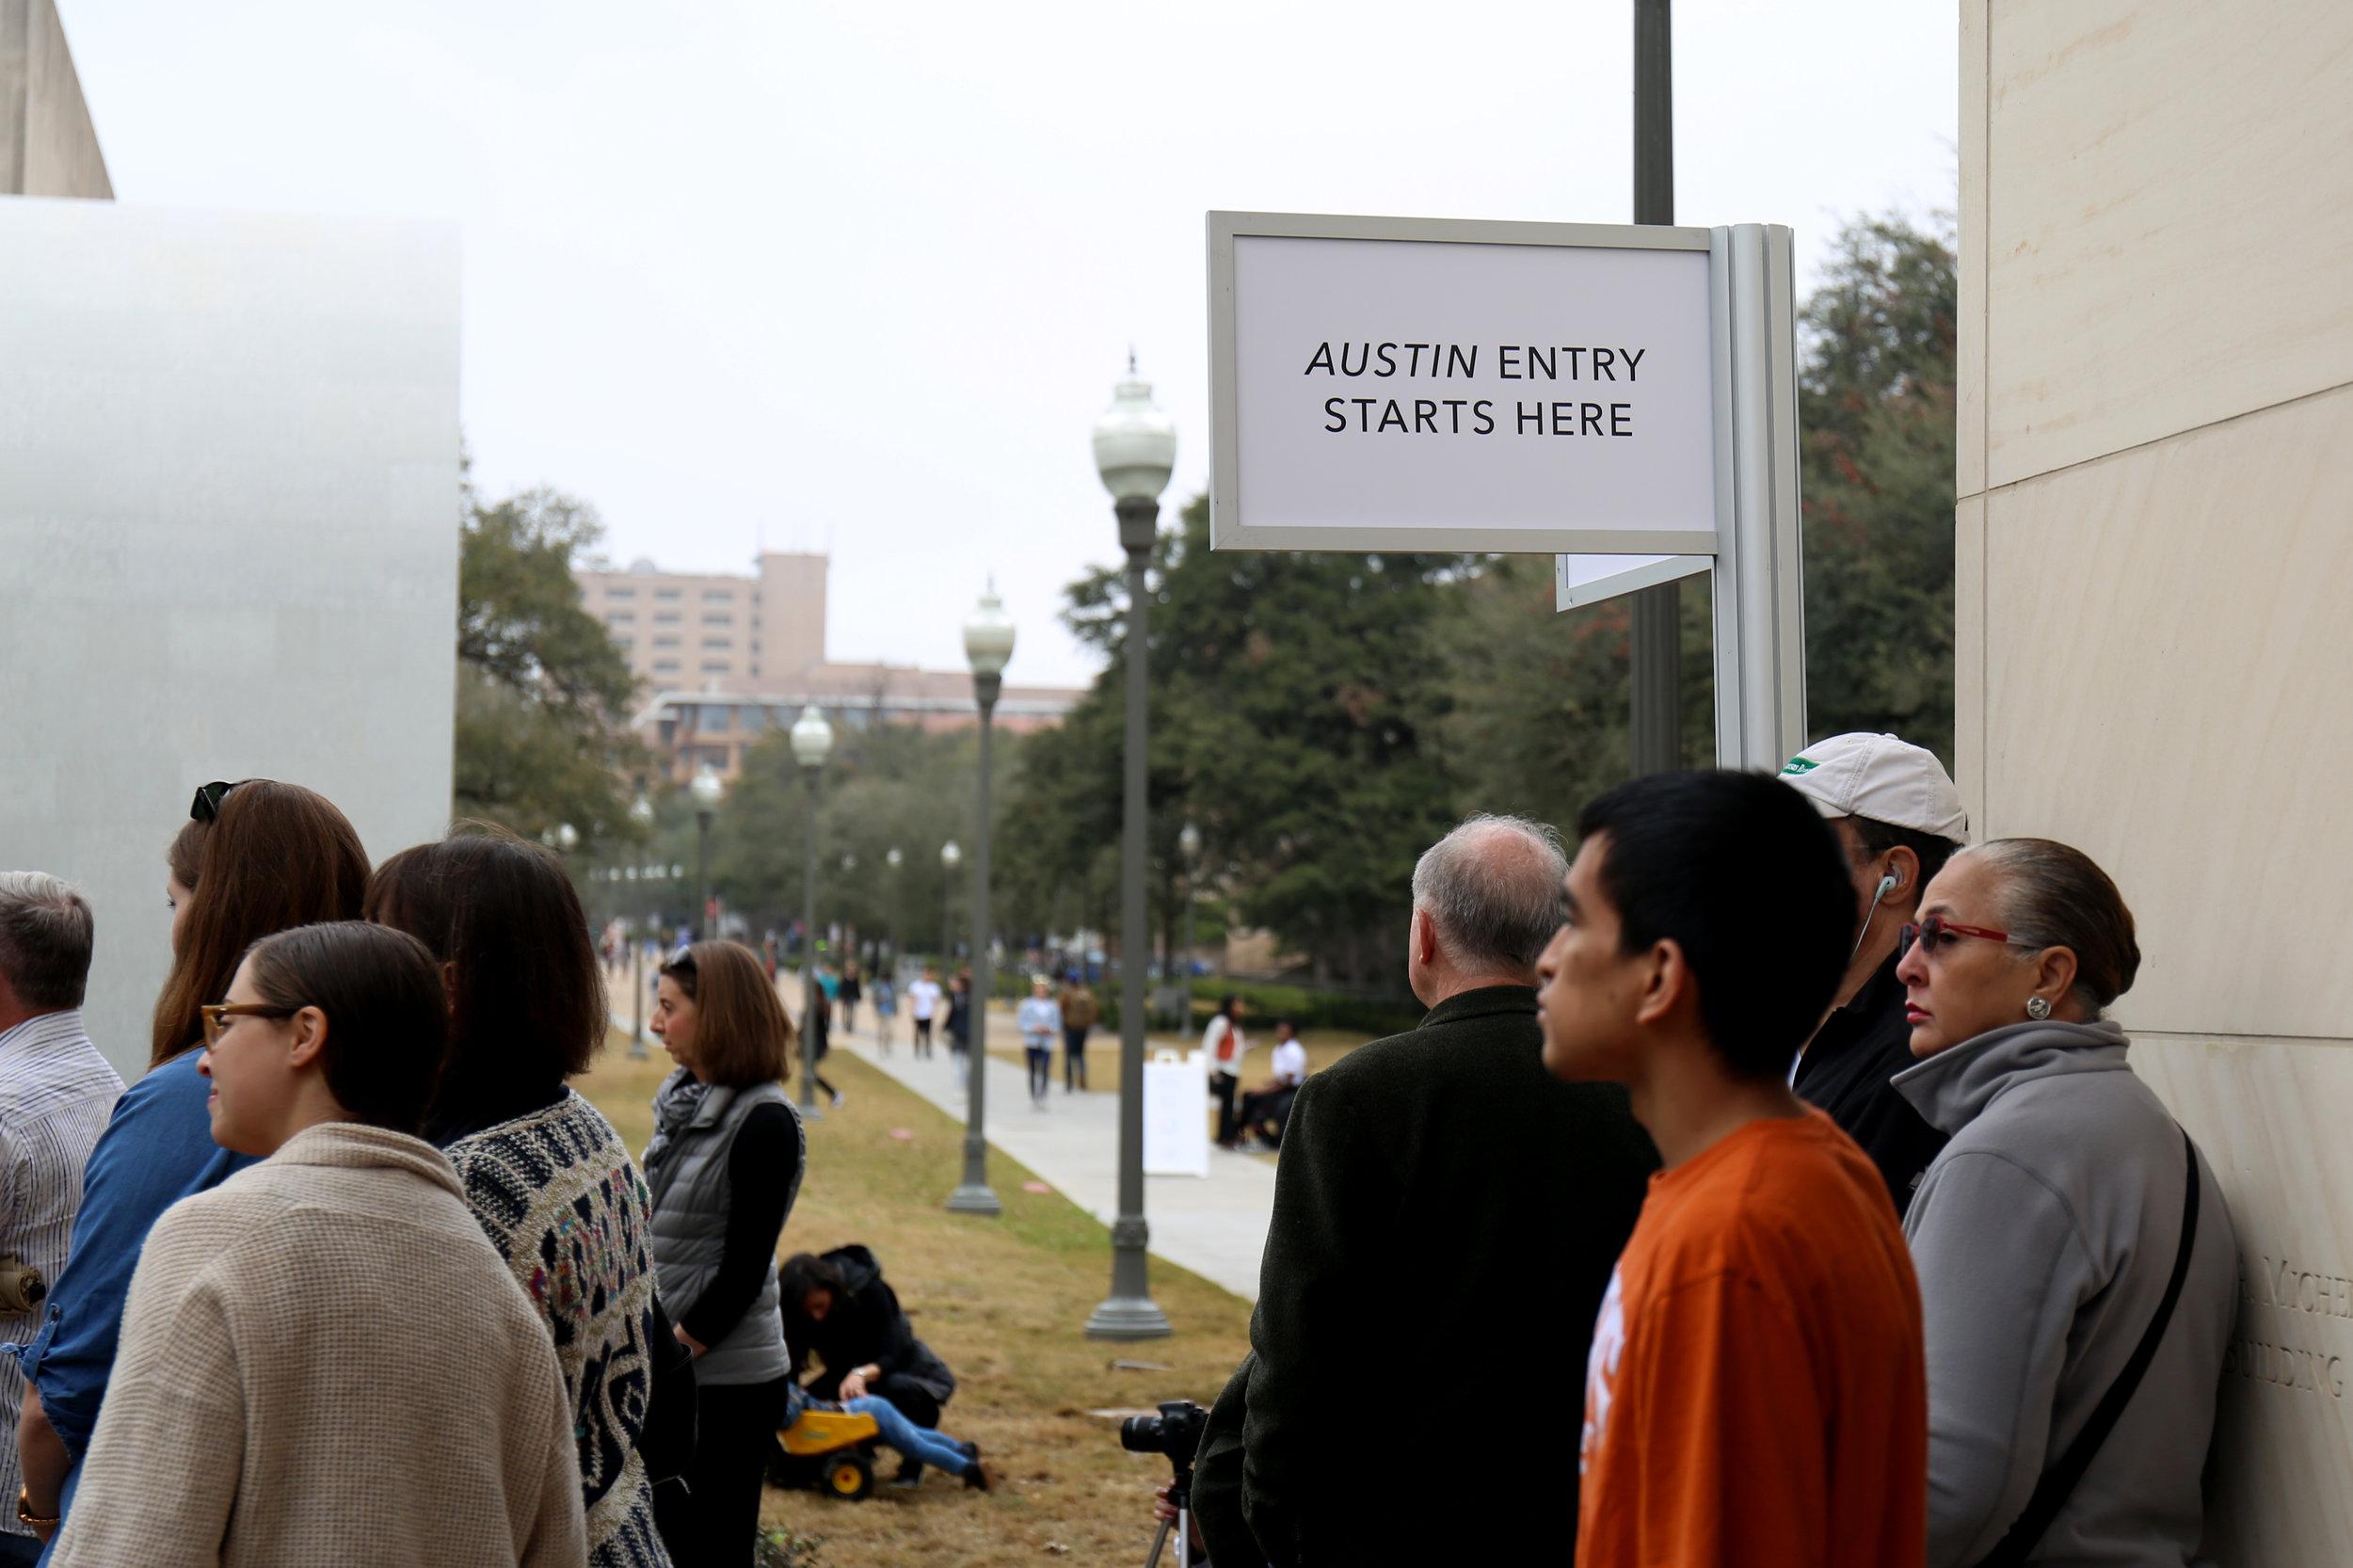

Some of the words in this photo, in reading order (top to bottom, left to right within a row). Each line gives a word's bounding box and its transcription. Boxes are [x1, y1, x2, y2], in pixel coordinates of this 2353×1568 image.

[1305, 343, 1477, 377] AUSTIN
[1500, 346, 1645, 381] ENTRY
[1325, 398, 1494, 435] STARTS
[1517, 402, 1632, 436] HERE
[2260, 1256, 2353, 1320] MICHE
